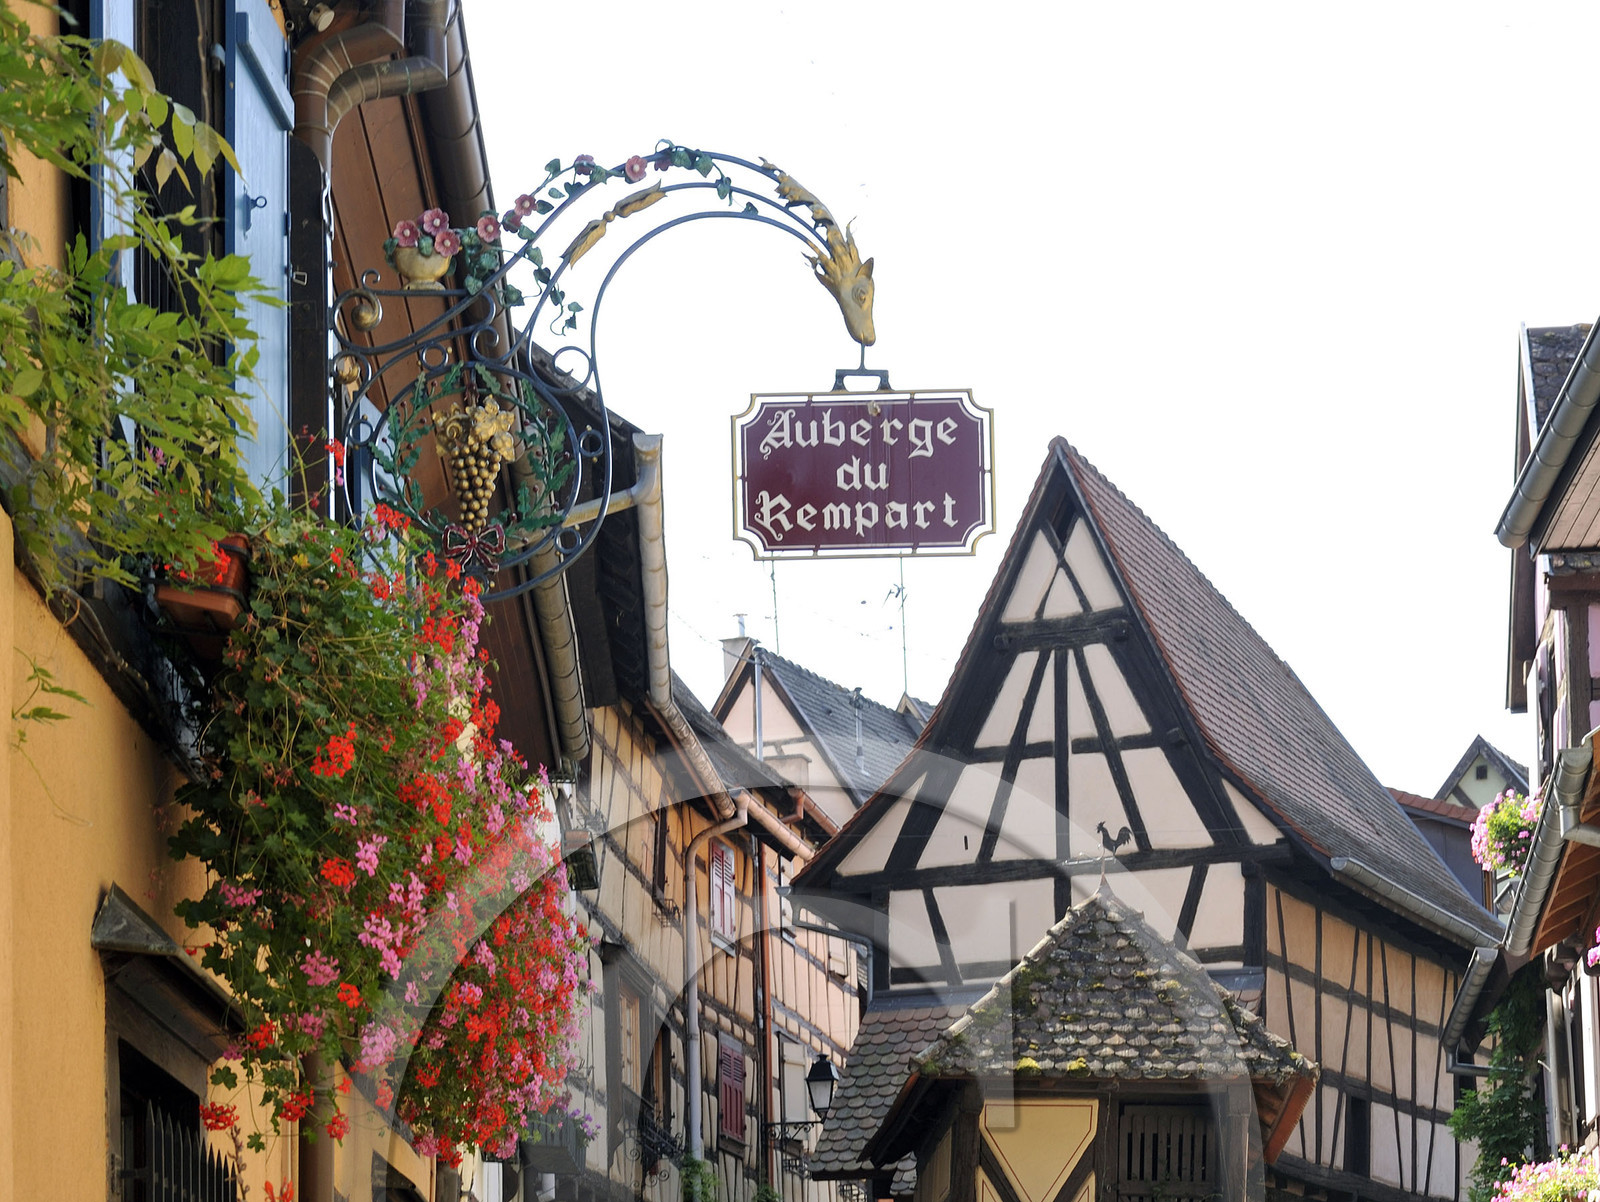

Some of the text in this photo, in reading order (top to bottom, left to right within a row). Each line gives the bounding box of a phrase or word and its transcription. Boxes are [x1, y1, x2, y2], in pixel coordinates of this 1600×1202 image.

[759, 408, 958, 460] Auberge
[836, 455, 889, 491] du
[754, 490, 958, 542] Rempart
